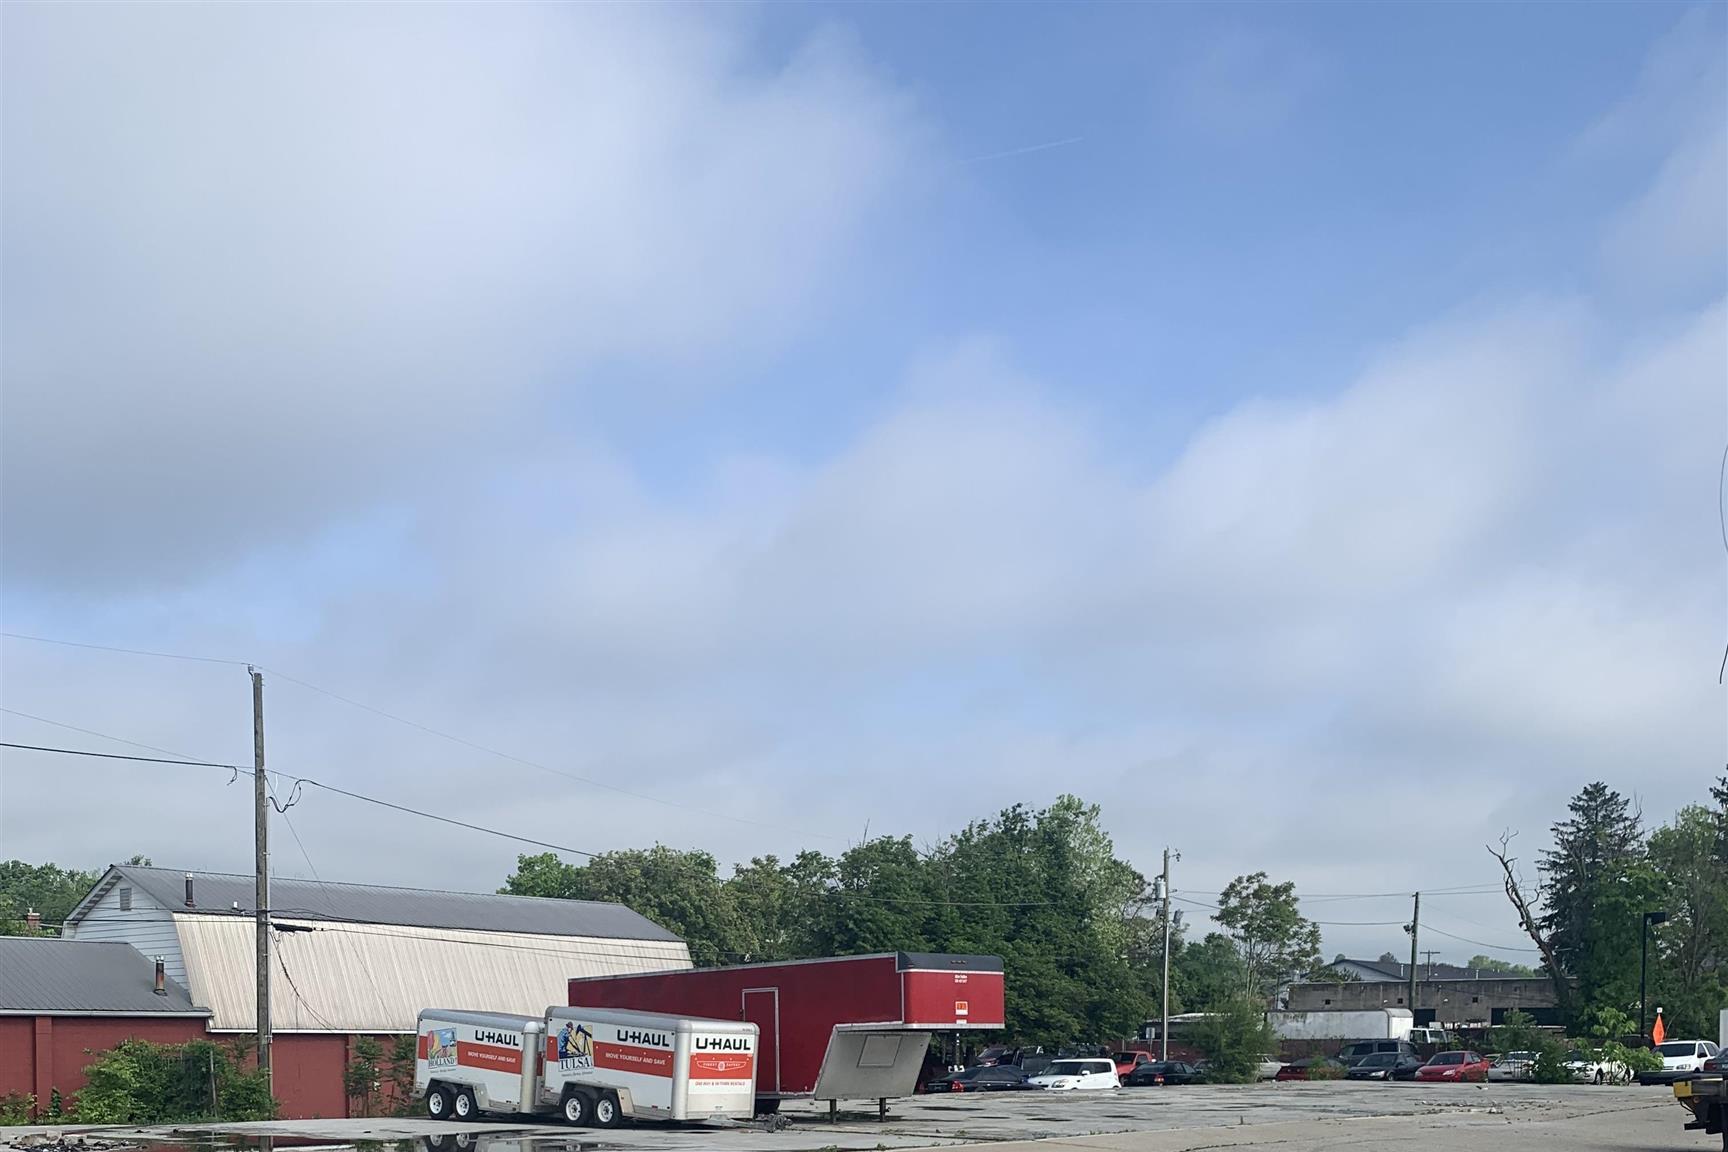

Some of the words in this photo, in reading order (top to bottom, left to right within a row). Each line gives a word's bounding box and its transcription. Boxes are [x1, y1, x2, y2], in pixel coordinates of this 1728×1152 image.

[475, 1029, 519, 1046] U-HAUL
[616, 1029, 670, 1047] U-HAUL
[696, 1037, 751, 1050] U-HAUL
[428, 1056, 455, 1066] HOLLAND
[560, 1057, 590, 1069] TULSA
[605, 1052, 619, 1060] MOVE
[619, 1054, 642, 1062] YOURSELF
[642, 1056, 653, 1064] AND
